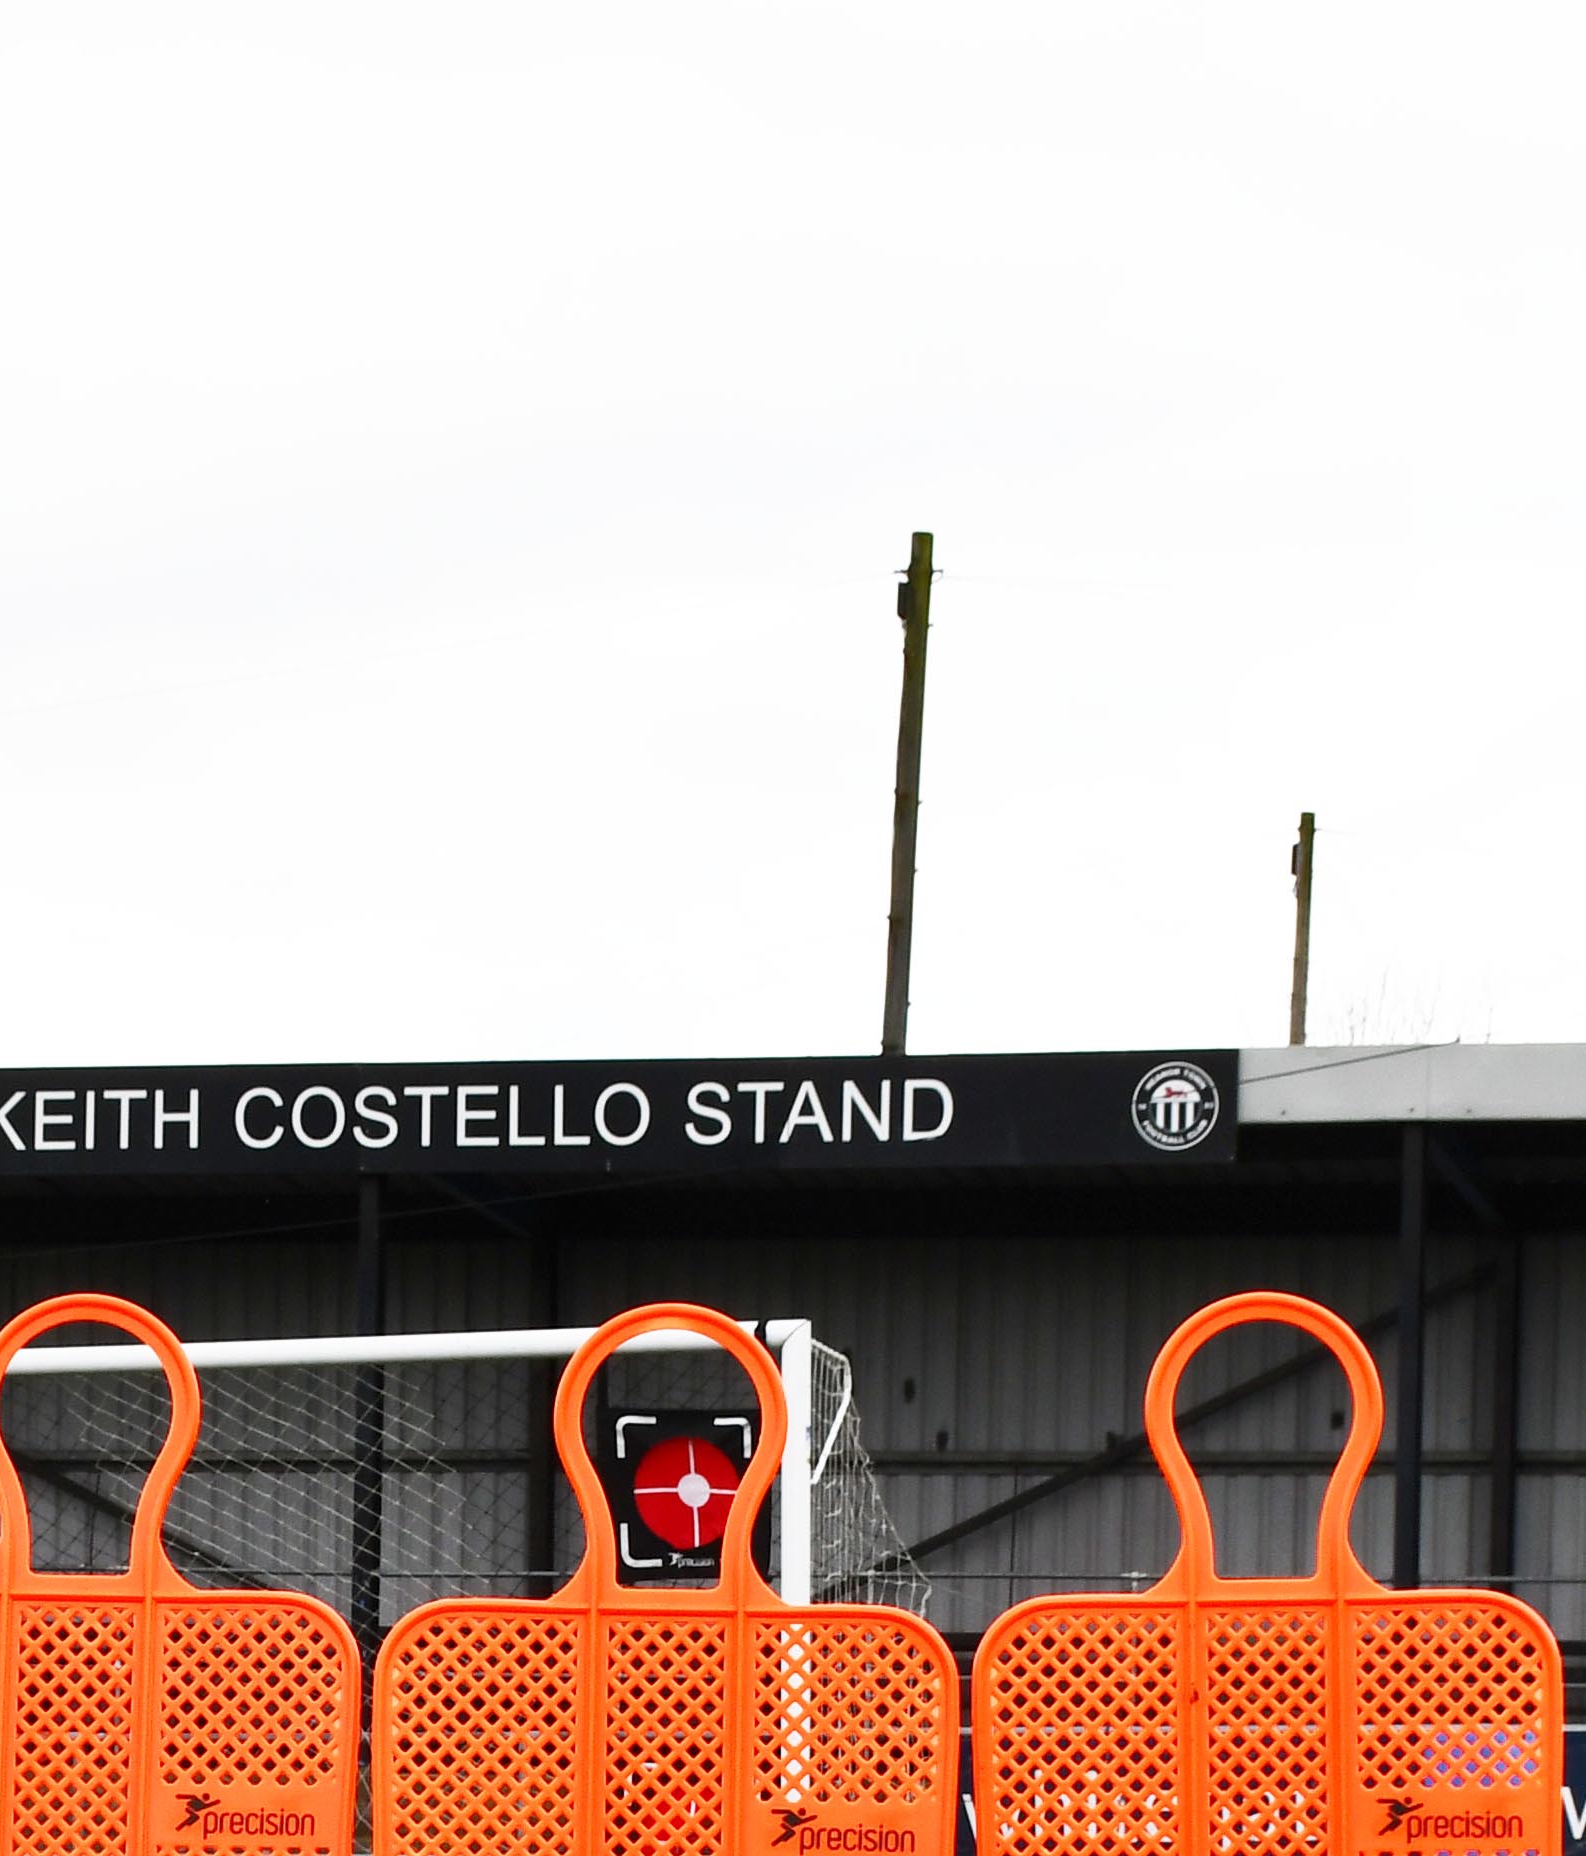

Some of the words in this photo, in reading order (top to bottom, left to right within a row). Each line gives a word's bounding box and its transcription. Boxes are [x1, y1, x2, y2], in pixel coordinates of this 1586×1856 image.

[234, 1082, 651, 1149] COSTELLO
[684, 1077, 955, 1145] STAND
[203, 1807, 315, 1840] precision
[799, 1823, 916, 1856] precision
[1406, 1810, 1524, 1844] precision
